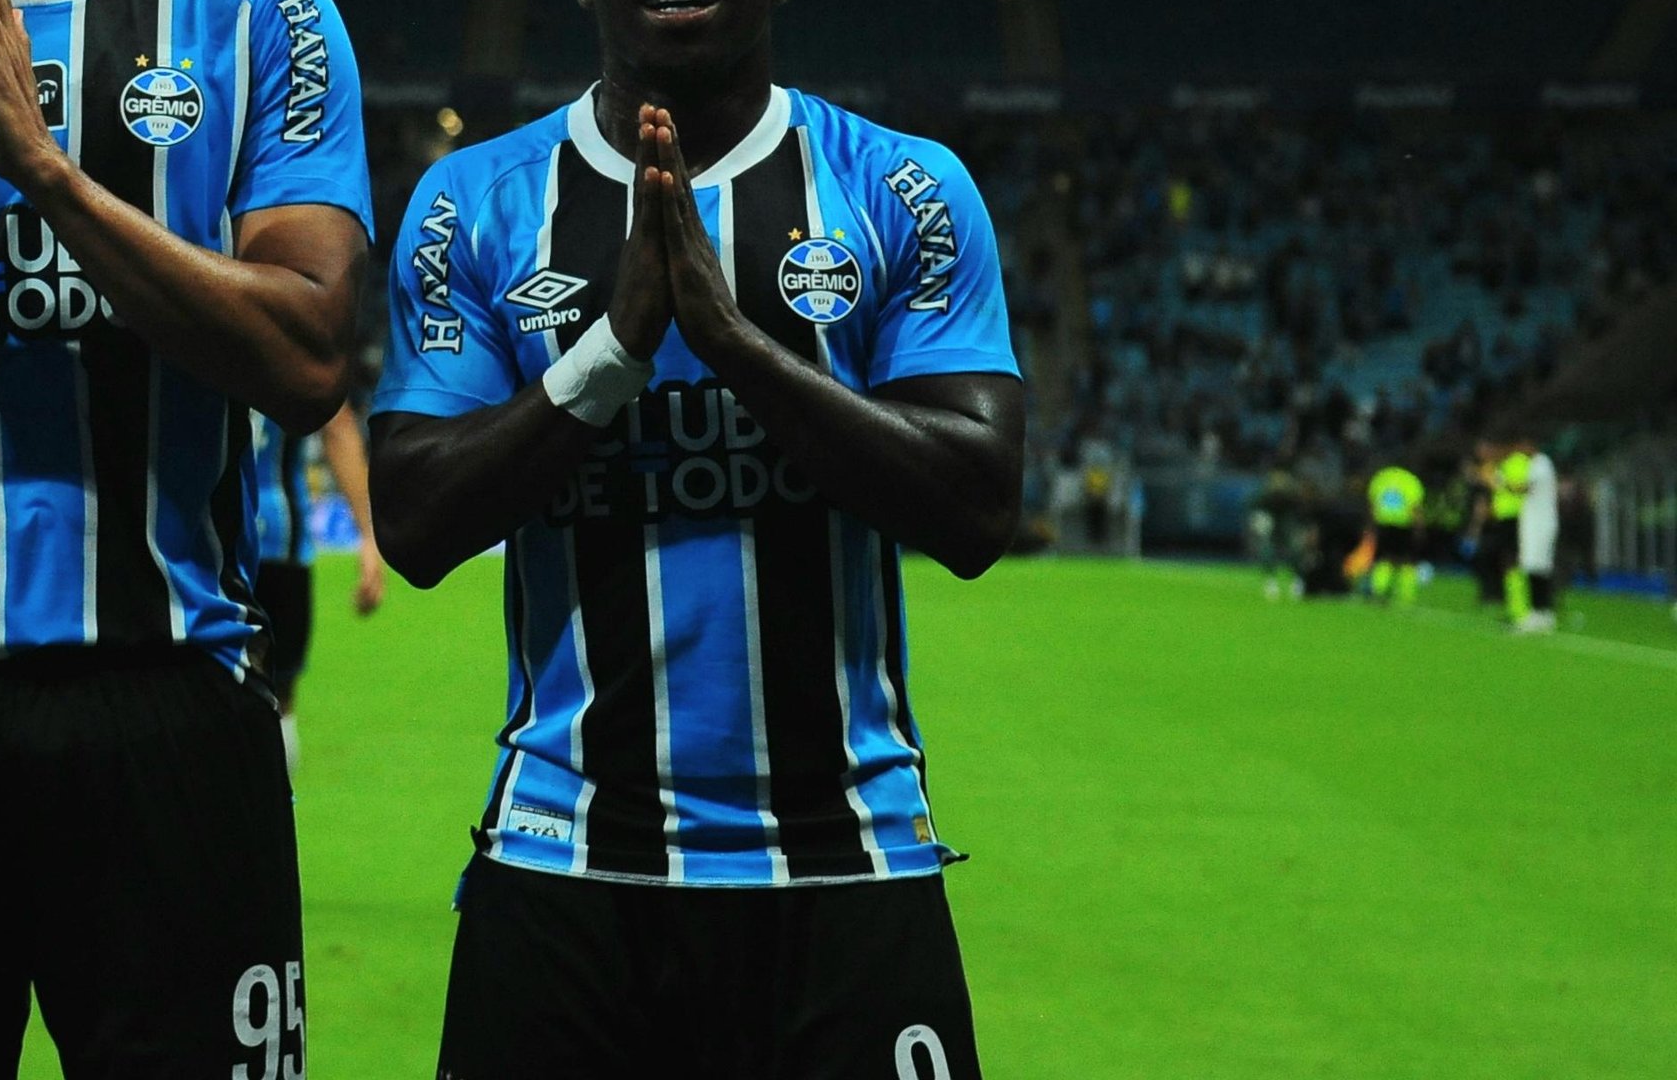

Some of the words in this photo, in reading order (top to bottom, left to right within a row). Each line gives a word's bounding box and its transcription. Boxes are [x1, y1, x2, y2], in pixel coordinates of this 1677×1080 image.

[125, 95, 199, 118] GRÊMIO
[884, 159, 956, 313] HAVAN
[783, 269, 857, 292] GRÊMIO
[519, 307, 582, 333] umbro
[230, 960, 306, 1080] 95
